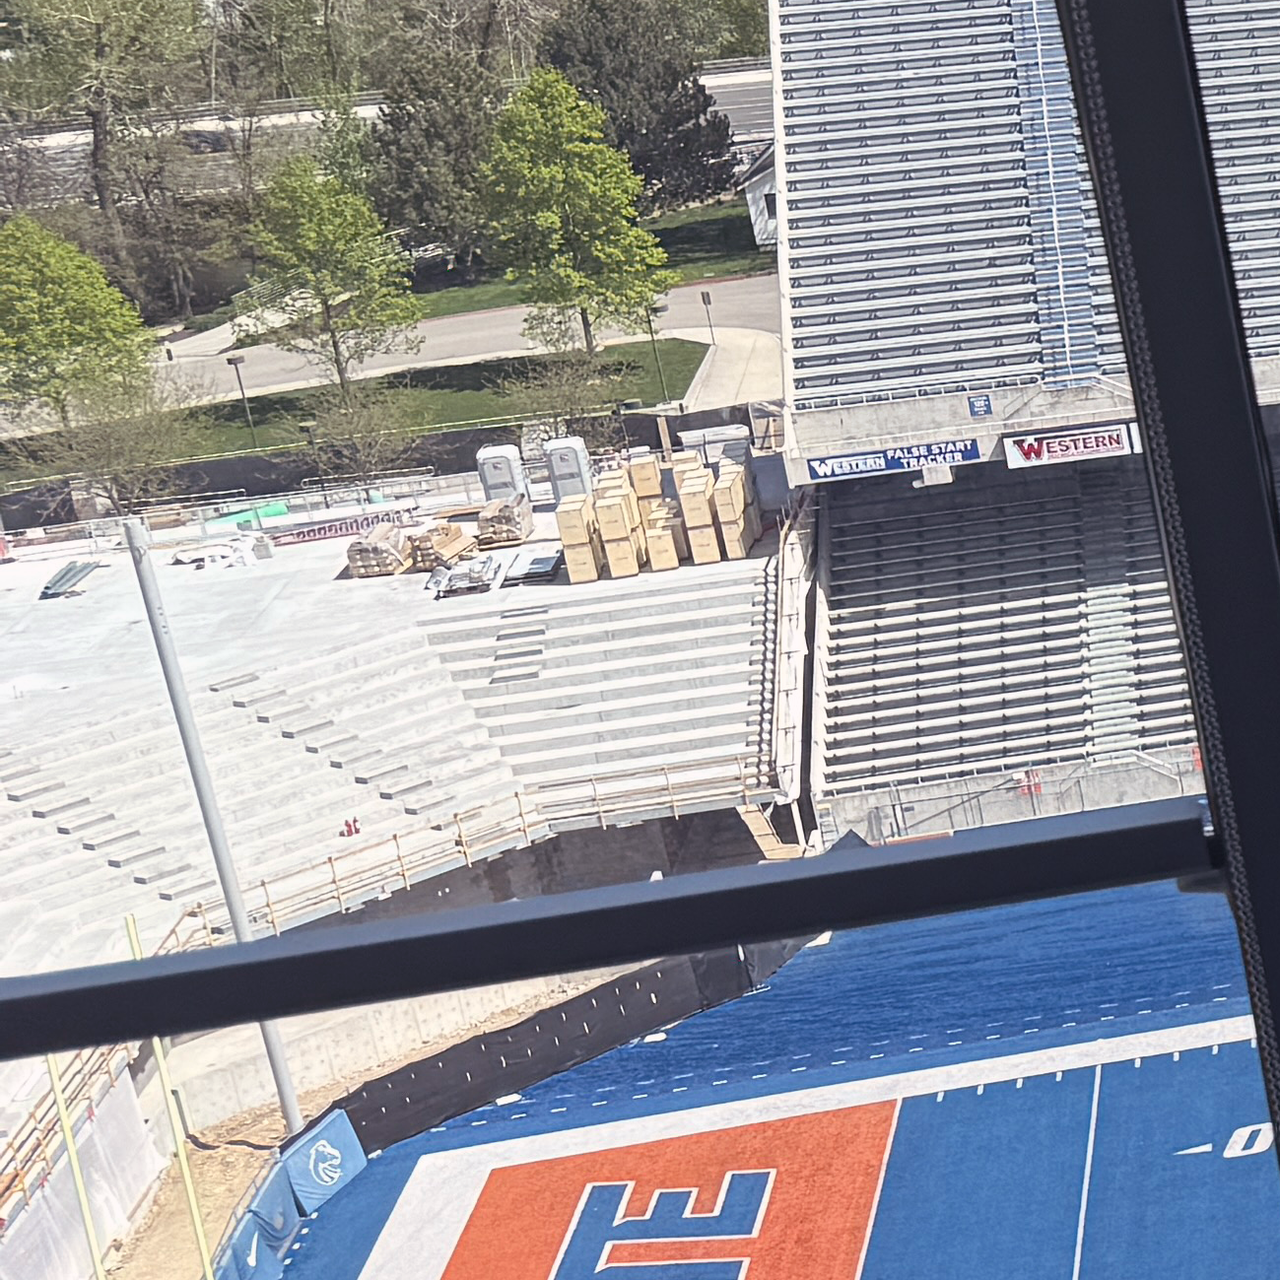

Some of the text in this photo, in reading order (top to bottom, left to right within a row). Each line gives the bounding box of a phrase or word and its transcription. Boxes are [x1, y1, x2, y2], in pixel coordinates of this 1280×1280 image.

[886, 440, 972, 460] FALSE START
[1013, 430, 1122, 462] WESTERN
[810, 454, 886, 477] WESTERN
[900, 453, 963, 469] TRACKER
